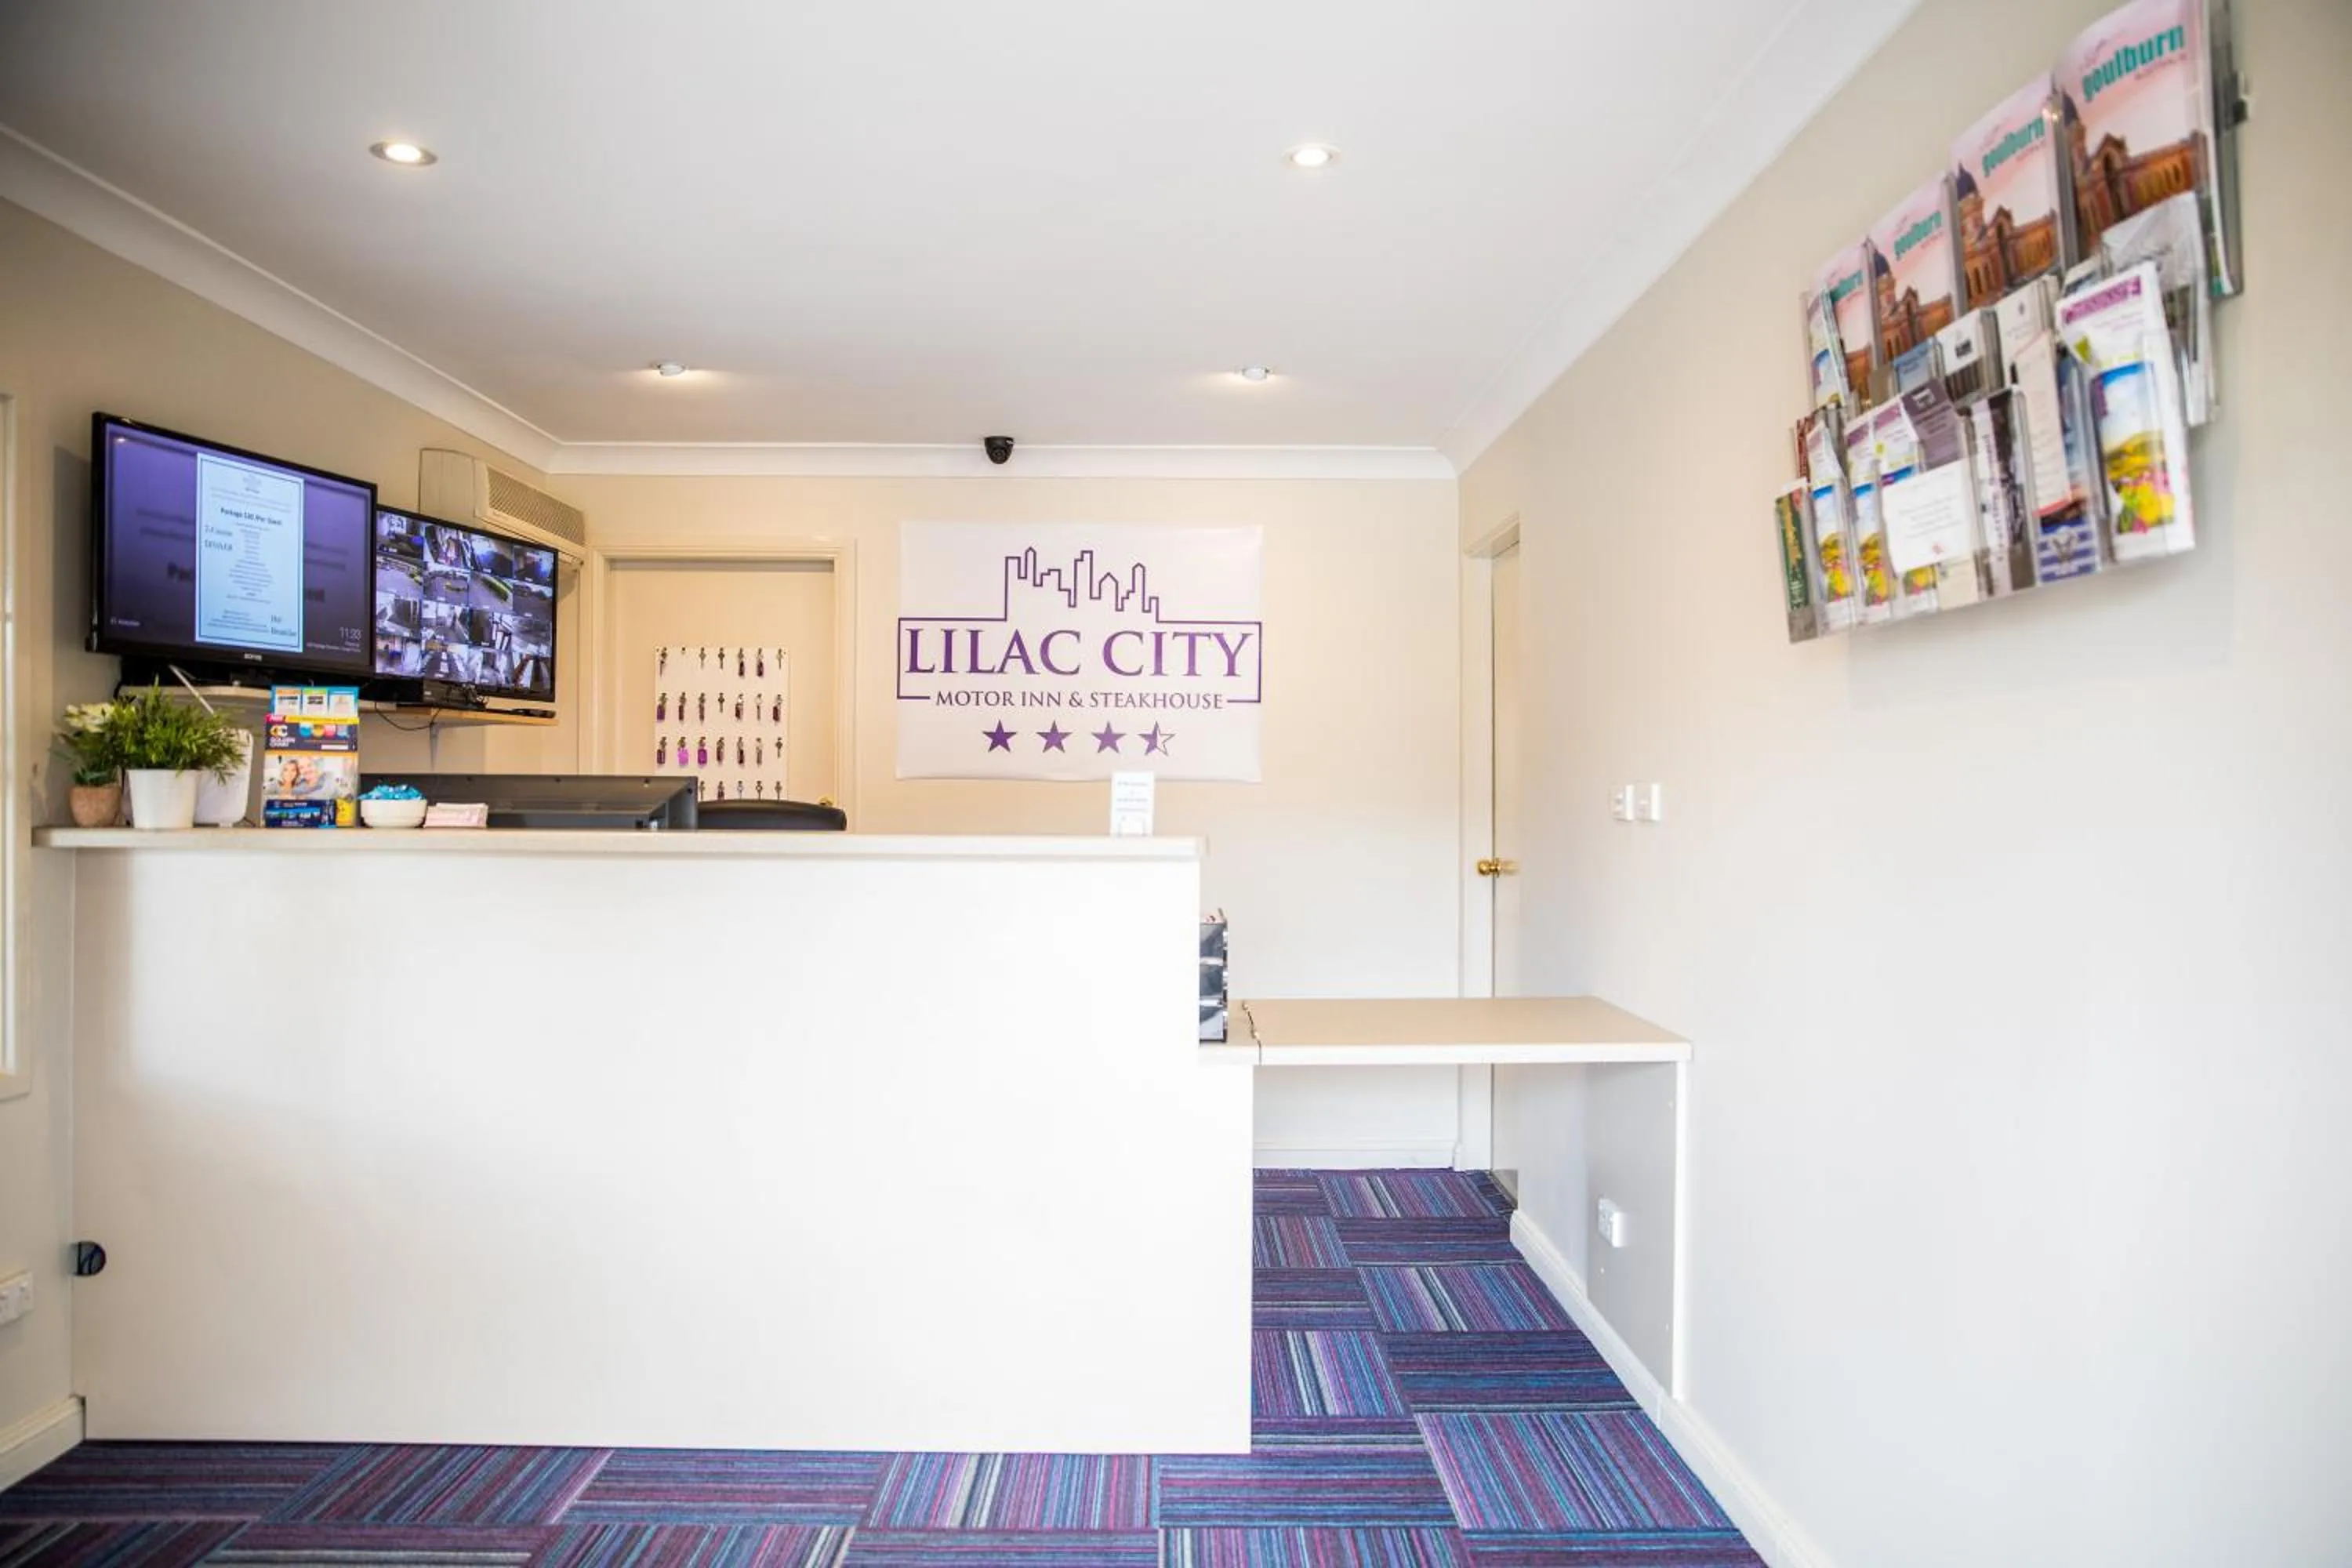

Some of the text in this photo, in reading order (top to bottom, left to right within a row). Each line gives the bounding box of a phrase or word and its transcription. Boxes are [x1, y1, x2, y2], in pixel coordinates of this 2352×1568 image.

[905, 628, 1254, 677] LILAC CITY
[936, 691, 1224, 710] MOTOR INN & STEAKHOUSE
